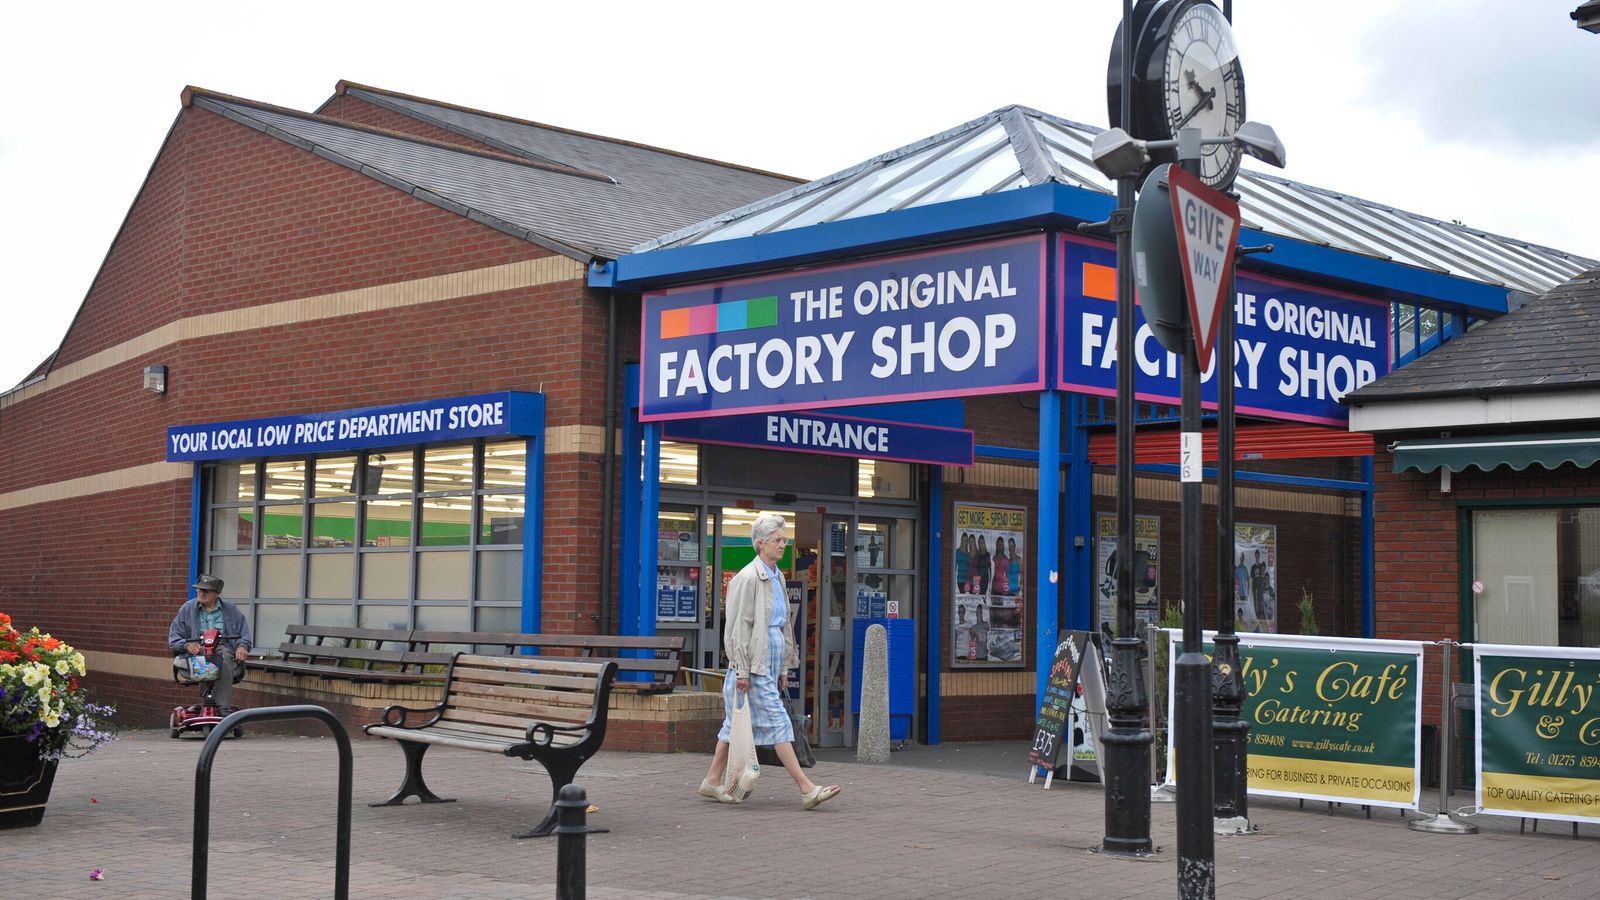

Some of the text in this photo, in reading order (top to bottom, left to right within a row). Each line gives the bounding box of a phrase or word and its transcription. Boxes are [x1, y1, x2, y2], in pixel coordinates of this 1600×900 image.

[1185, 199, 1224, 252] GIVE
[1193, 249, 1219, 284] WAY
[790, 262, 1017, 323] THE ORIGINAL
[1234, 292, 1376, 349] HE ORIGINAL
[658, 312, 1017, 399] FACTORY SHOP
[171, 401, 503, 454] YOUR LOCAL LOW PRICE DEPARTMENT STORE
[766, 416, 889, 453] ENTRANCE
[958, 510, 969, 524] GET
[970, 511, 985, 525] MORE
[990, 511, 1009, 526] SPEND
[1009, 512, 1023, 526] LESS
[1315, 661, 1409, 705] Café
[1253, 699, 1362, 732] Catering
[1535, 714, 1565, 739] &
[1254, 732, 1286, 747] 859408
[1291, 738, 1376, 754] www.gillyscafe.co.uk
[1547, 753, 1576, 767] 01275
[1247, 767, 1412, 793] RING FOR BUSINESS & PRIVATE OCCASIONS
[1487, 786, 1504, 799] TOP
[1506, 788, 1544, 802] QUALITY
[1545, 791, 1593, 806] CATERING
